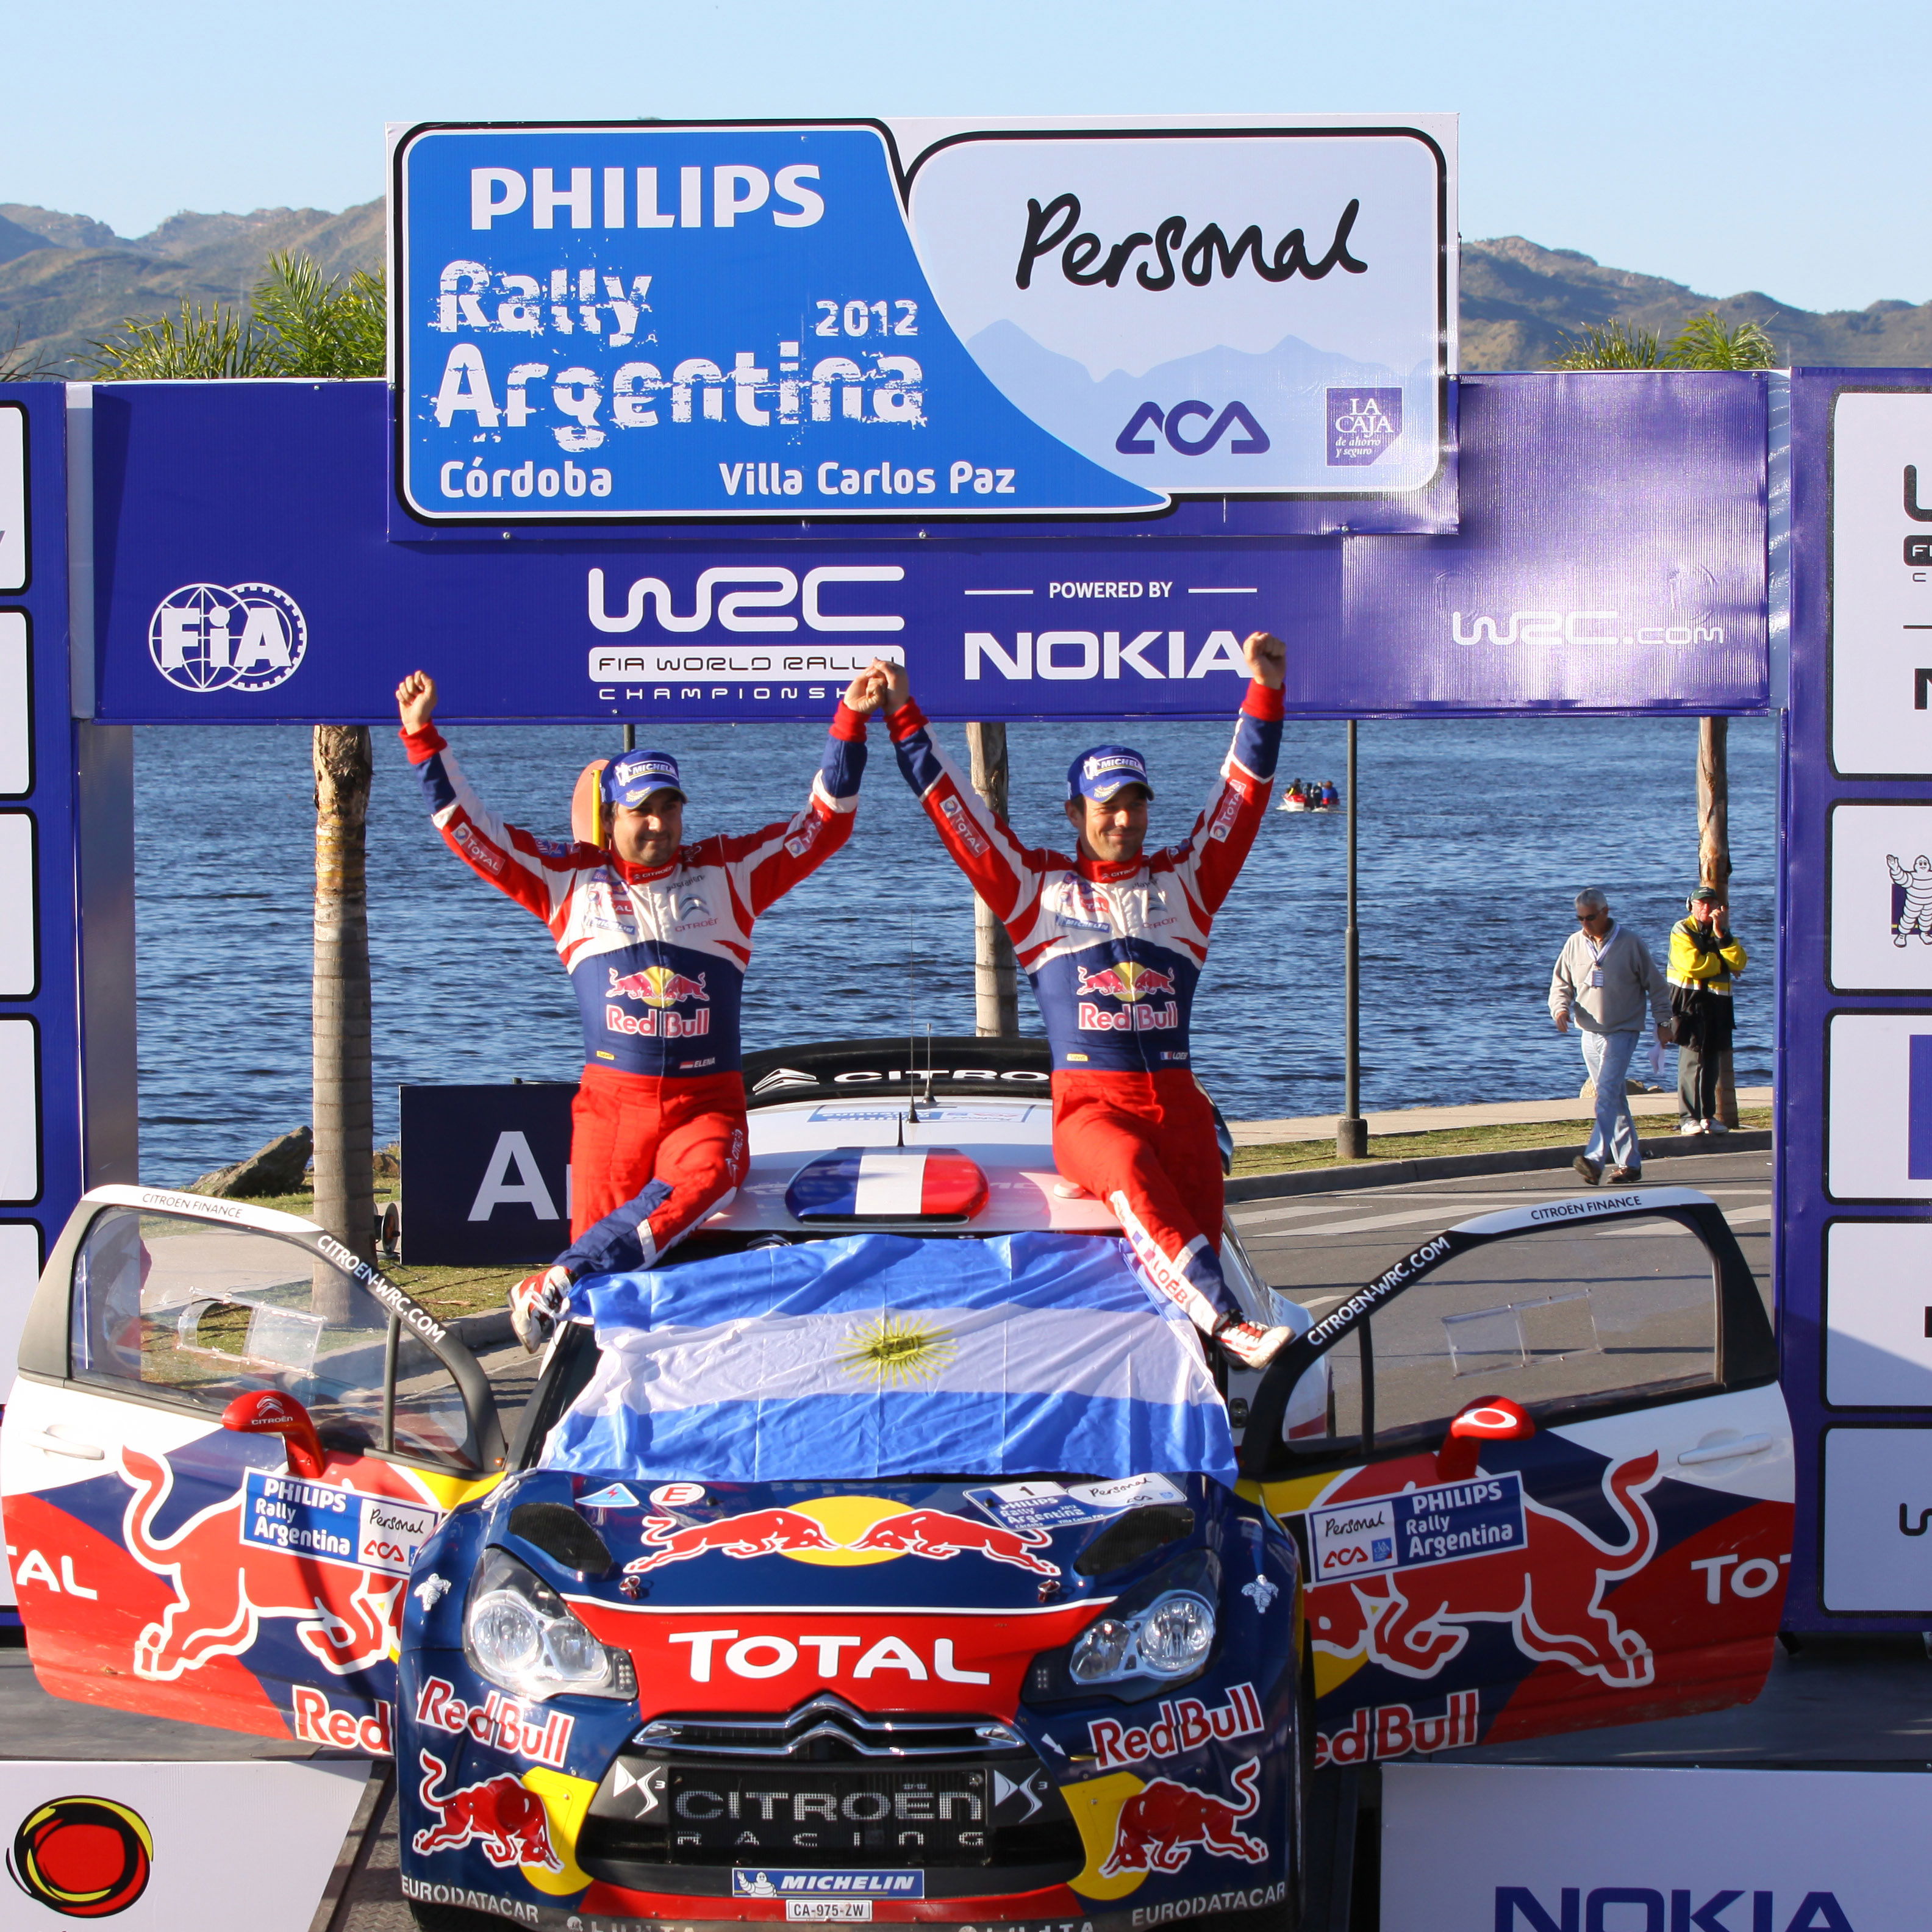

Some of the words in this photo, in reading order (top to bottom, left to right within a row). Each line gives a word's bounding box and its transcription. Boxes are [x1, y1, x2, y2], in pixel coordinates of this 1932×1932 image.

[471, 165, 825, 230] PHILIPS
[1015, 193, 1368, 292] Personal
[438, 260, 653, 348] Rally
[815, 299, 919, 337] 2012
[434, 342, 926, 453] Argentina
[1350, 398, 1382, 415] LA
[1115, 400, 1270, 456] ACA
[1336, 415, 1395, 438] CAJA
[1336, 437, 1347, 446] de
[1349, 437, 1381, 446] ahorro
[1336, 448, 1342, 458] y
[1343, 448, 1372, 458] seguro
[440, 457, 612, 498] Córdoba
[719, 462, 803, 496] Villa
[818, 462, 936, 495] Carlos
[950, 461, 1015, 493] Paz
[589, 567, 904, 632] WRC
[1049, 582, 1143, 598] POWERED
[1149, 582, 1173, 597] BY
[599, 657, 644, 671] FIA
[657, 657, 771, 670] WORLD
[784, 657, 894, 670] RALL
[965, 631, 1253, 680] NOKIA
[954, 815, 982, 853] TOTAL
[465, 839, 499, 871] TOTAL
[606, 1004, 657, 1036] Red
[665, 1008, 709, 1037] Bull
[1078, 1002, 1131, 1031] Red
[1136, 1001, 1178, 1031] Bull
[693, 1057, 716, 1068] ELENA
[834, 1070, 1050, 1083] CITRO
[192, 1201, 243, 1218] FINANCE
[1531, 1202, 1584, 1220] CITROËN
[1586, 1196, 1642, 1212] FINANCE
[264, 1478, 346, 1512] PHILIPS
[662, 1487, 692, 1502] E
[1019, 1486, 1035, 1495] 1
[1089, 1477, 1152, 1497] Personal
[1412, 1481, 1501, 1515] PHILIPS
[255, 1498, 296, 1523] Rally
[999, 1497, 1059, 1511] PHILIPS
[1000, 1508, 1035, 1517] Rally
[1007, 1508, 1086, 1524] Argentina
[254, 1515, 351, 1555] Argentina
[370, 1508, 424, 1533] Personal
[1325, 1511, 1385, 1537] Personal
[1406, 1515, 1450, 1535] Rally
[1409, 1523, 1512, 1558] Argentina
[668, 1630, 990, 1685] TOTAL
[292, 1684, 394, 1755] Red
[415, 1676, 500, 1745] Red
[495, 1697, 575, 1768] Bull
[1087, 1700, 1178, 1770] Red
[1175, 1681, 1264, 1752] Bull
[1374, 1689, 1479, 1761] Bull
[676, 1783, 982, 1820] CITROËN
[677, 1831, 983, 1846] RACING
[781, 1875, 915, 1890] MICHELIN
[402, 1875, 539, 1923] EURODATACAR
[794, 1903, 864, 1917] CA-975-ZW
[1132, 1881, 1286, 1927] EURODATACAR
[1494, 1886, 1855, 1932] NOKIA
